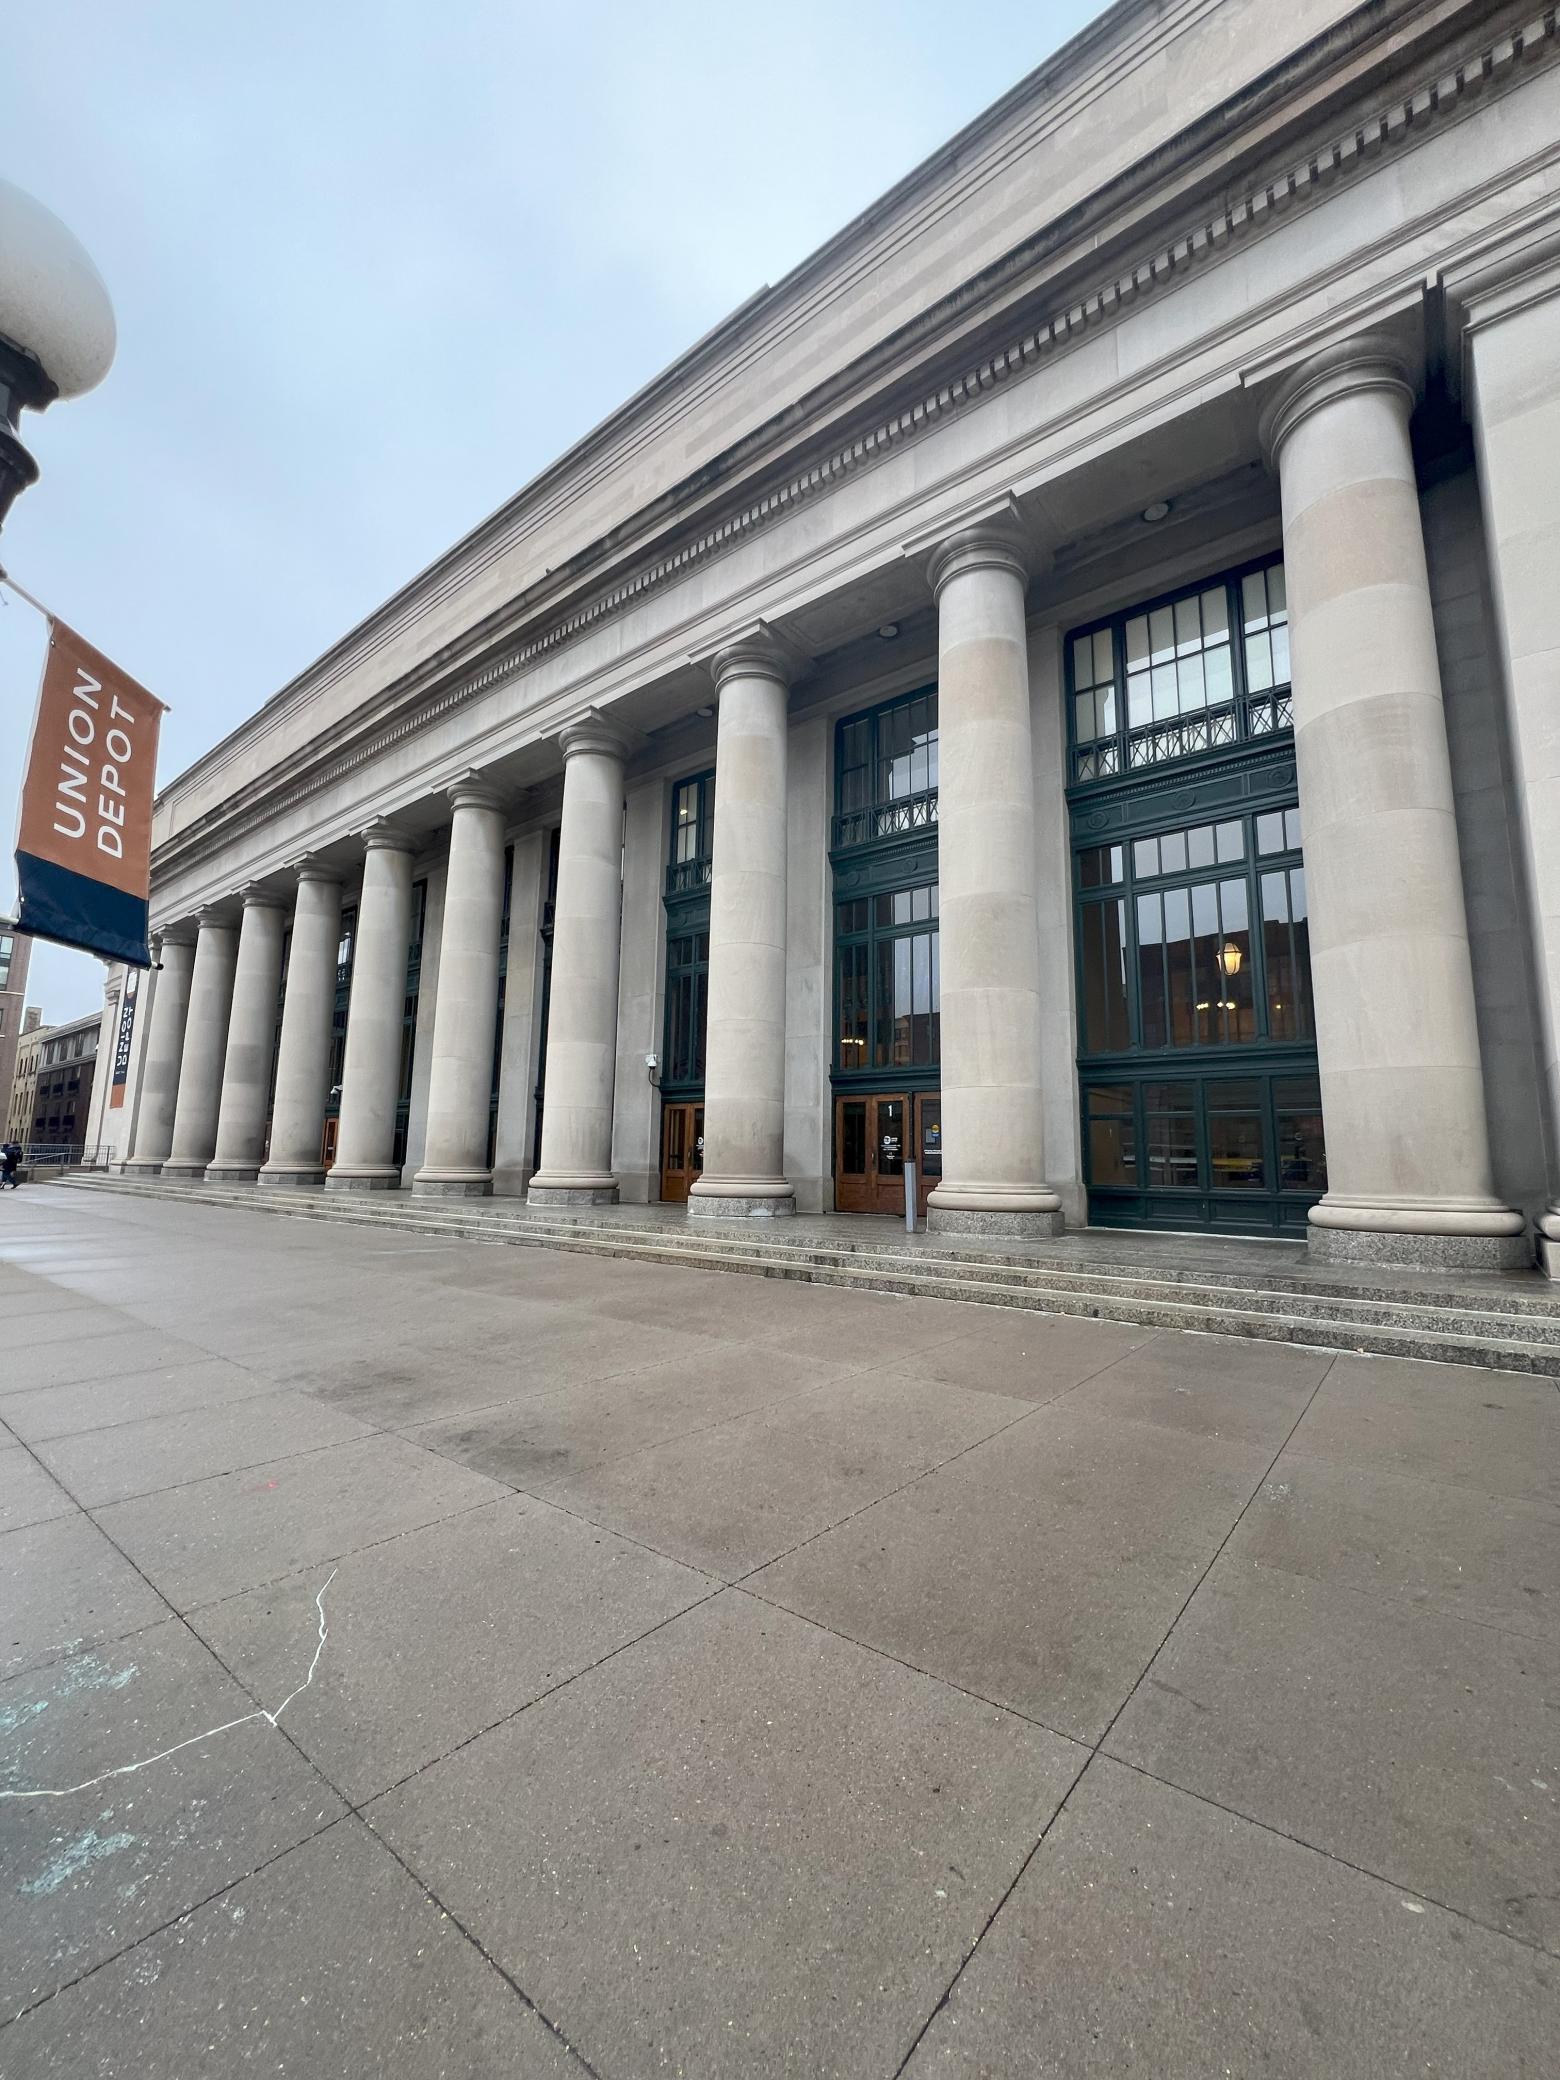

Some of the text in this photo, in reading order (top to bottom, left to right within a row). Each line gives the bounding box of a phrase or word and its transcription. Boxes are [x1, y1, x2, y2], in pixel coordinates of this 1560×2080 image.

[53, 667, 102, 839] UNION
[97, 694, 135, 859] DEPOT
[117, 1007, 129, 1066] UNION
[888, 1104, 893, 1117] 1
